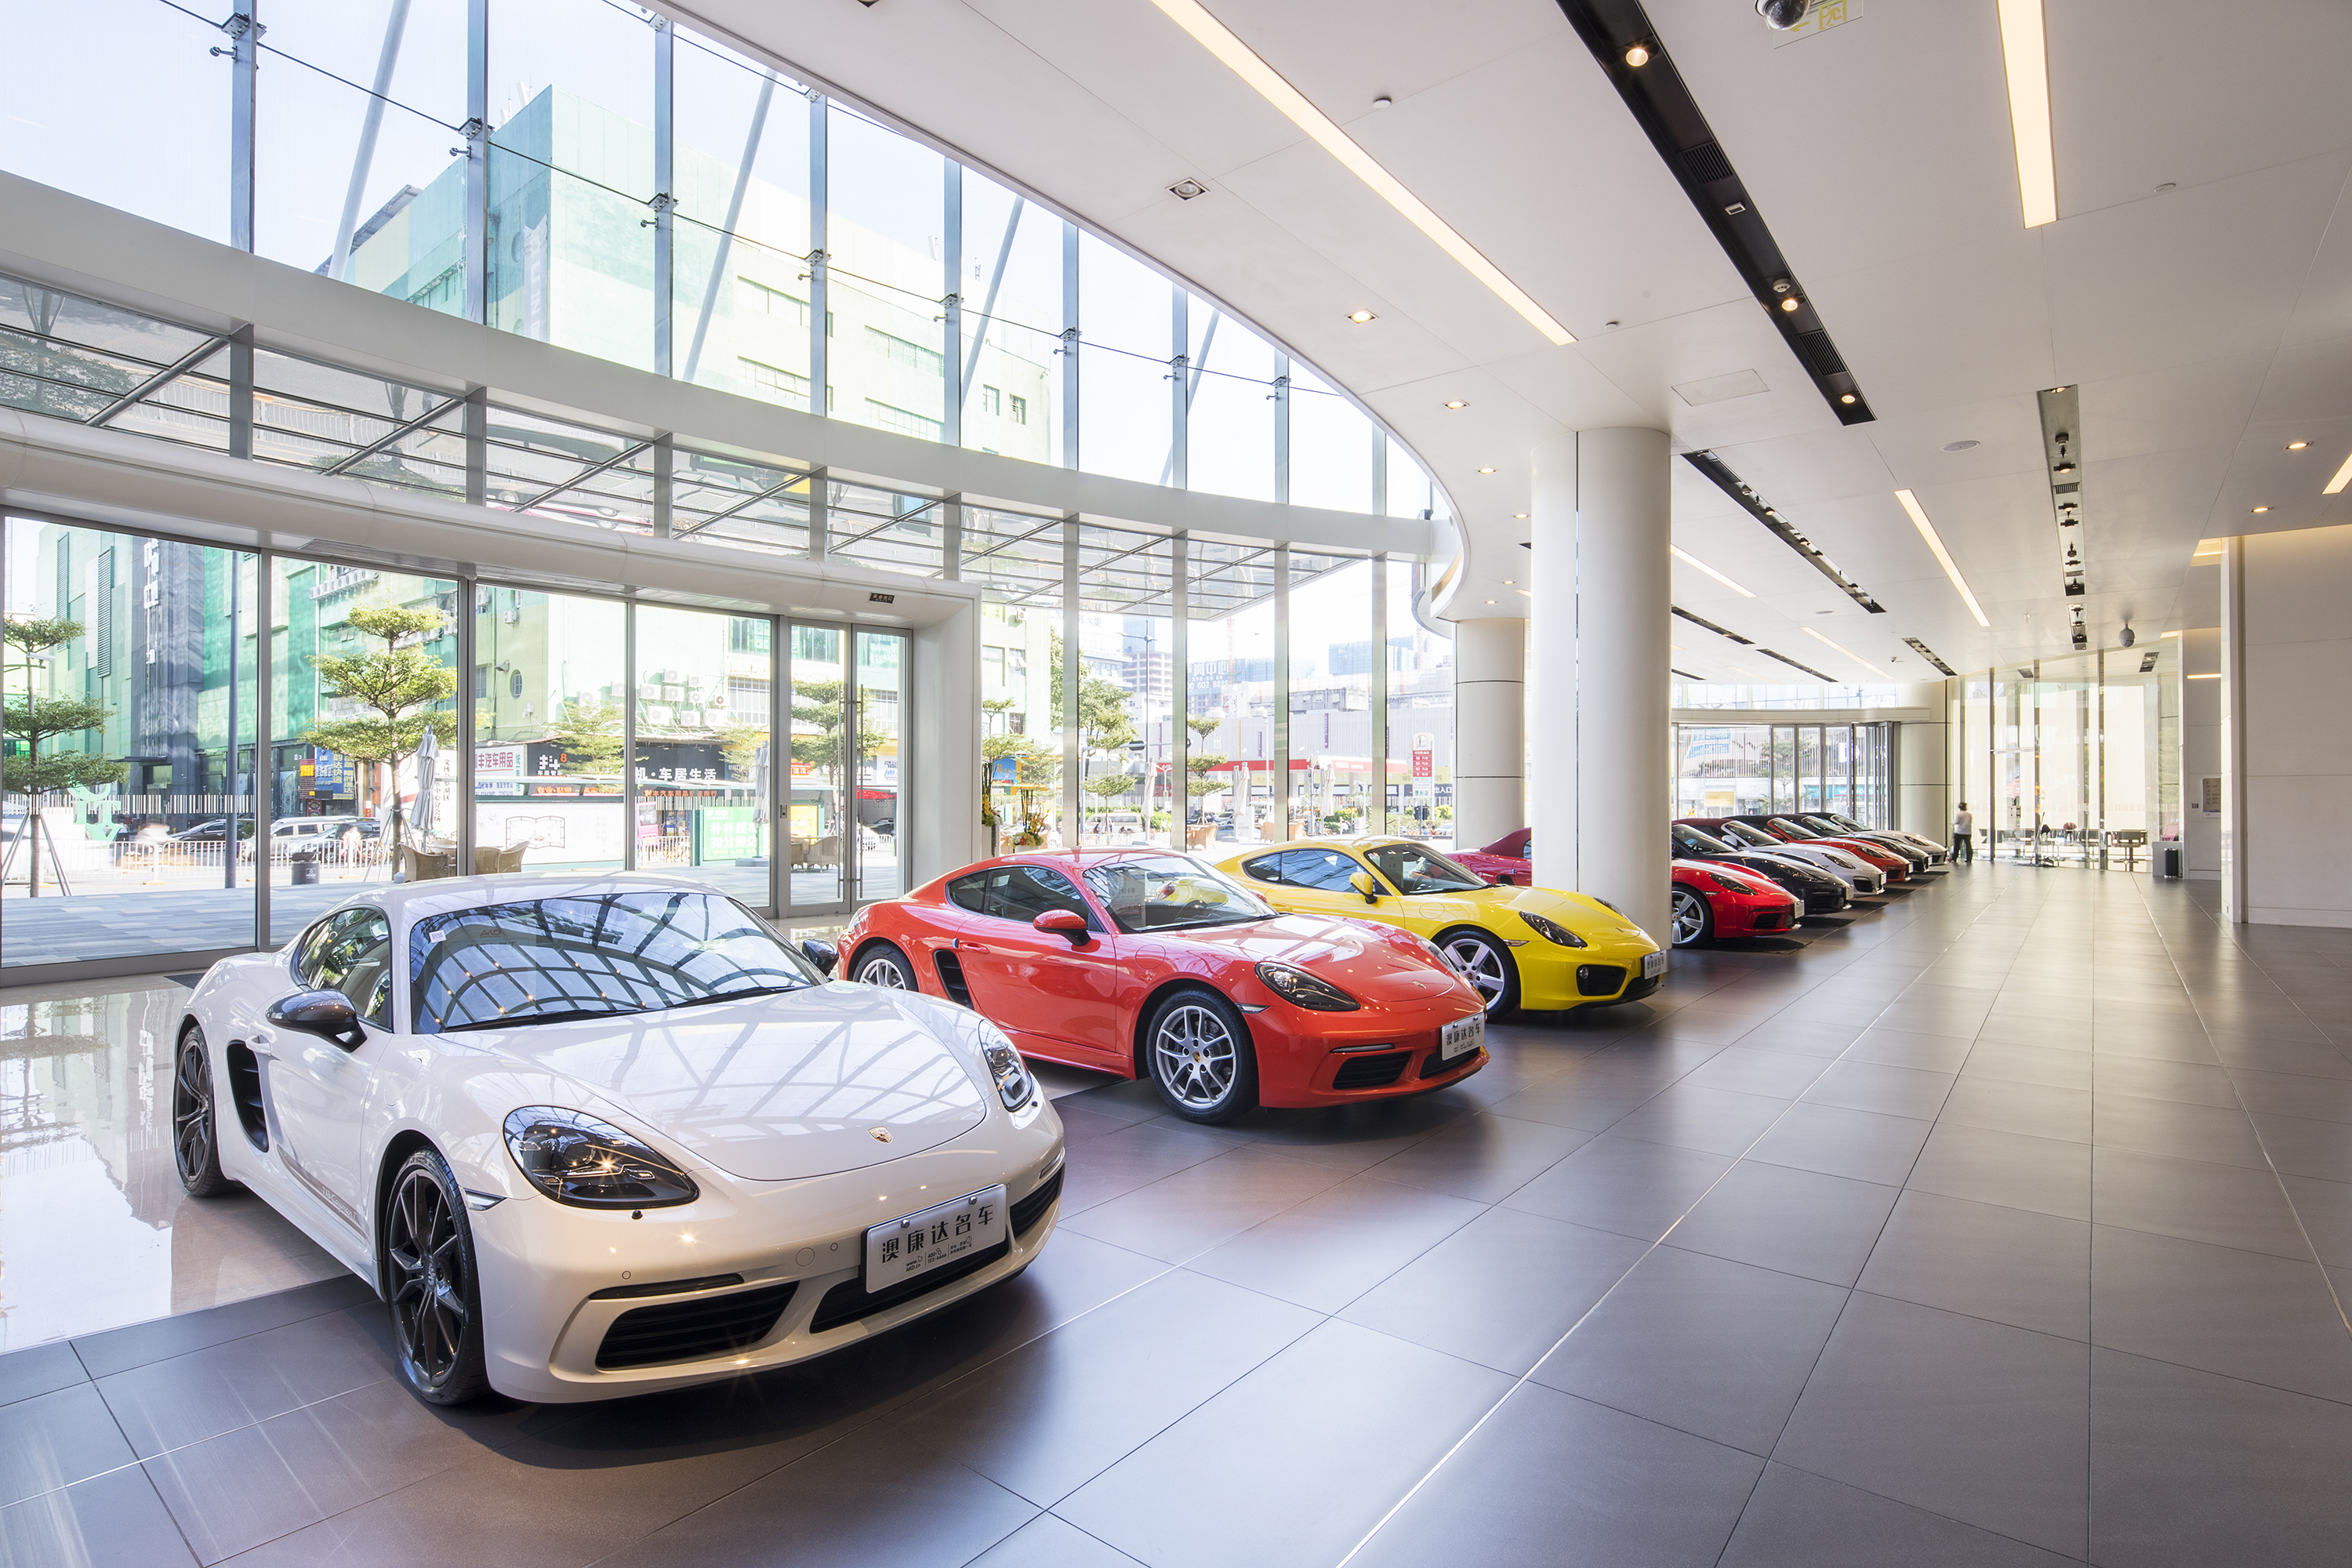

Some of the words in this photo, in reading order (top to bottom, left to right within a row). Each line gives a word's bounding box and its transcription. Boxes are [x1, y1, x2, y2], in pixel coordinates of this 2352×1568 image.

[1446, 1022, 1481, 1046] 澳康达名车
[331, 1194, 353, 1218] Cayman
[882, 1204, 993, 1264] 澳康达名车
[906, 1264, 921, 1272] AKD.cn
